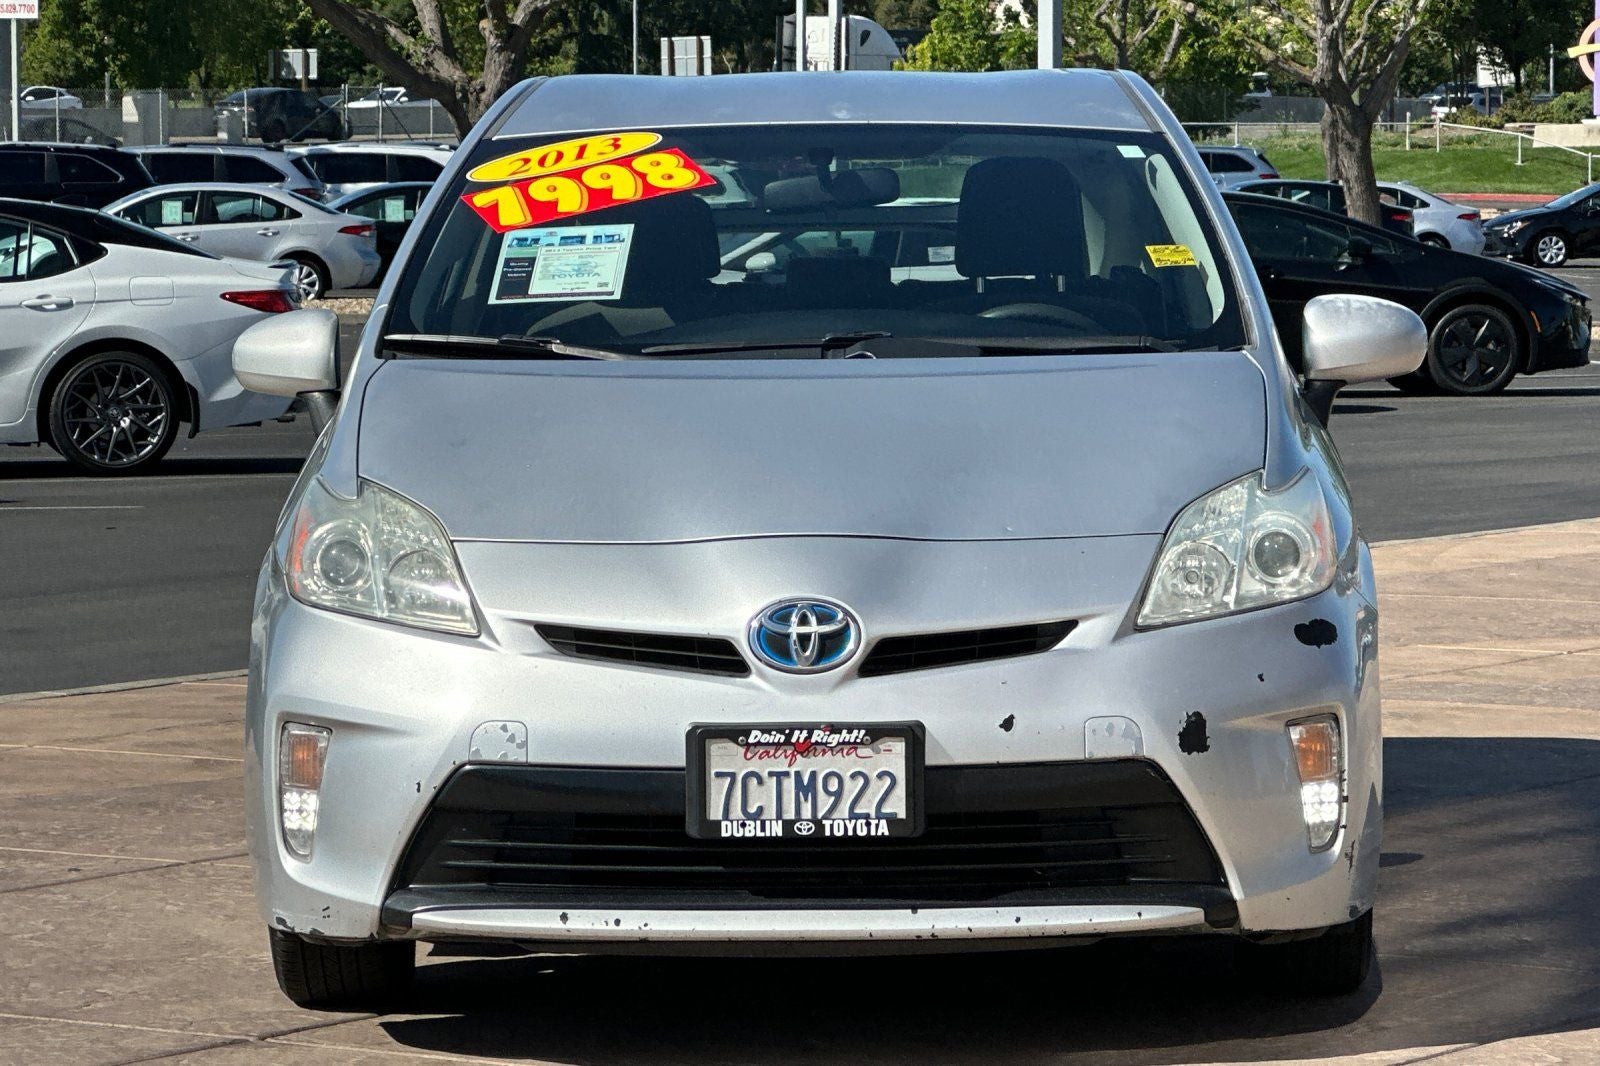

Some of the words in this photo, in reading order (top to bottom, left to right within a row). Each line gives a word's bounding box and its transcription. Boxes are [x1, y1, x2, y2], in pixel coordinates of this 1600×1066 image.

[507, 136, 622, 177] 2013
[472, 153, 700, 226] 7998
[743, 742, 873, 767] California
[748, 729, 789, 744] Doin'
[791, 730, 808, 744] It
[811, 729, 866, 748] Right!
[713, 769, 898, 820] 7CTM922
[720, 820, 783, 837] DUBLIN
[822, 819, 889, 836] TOYOTA
